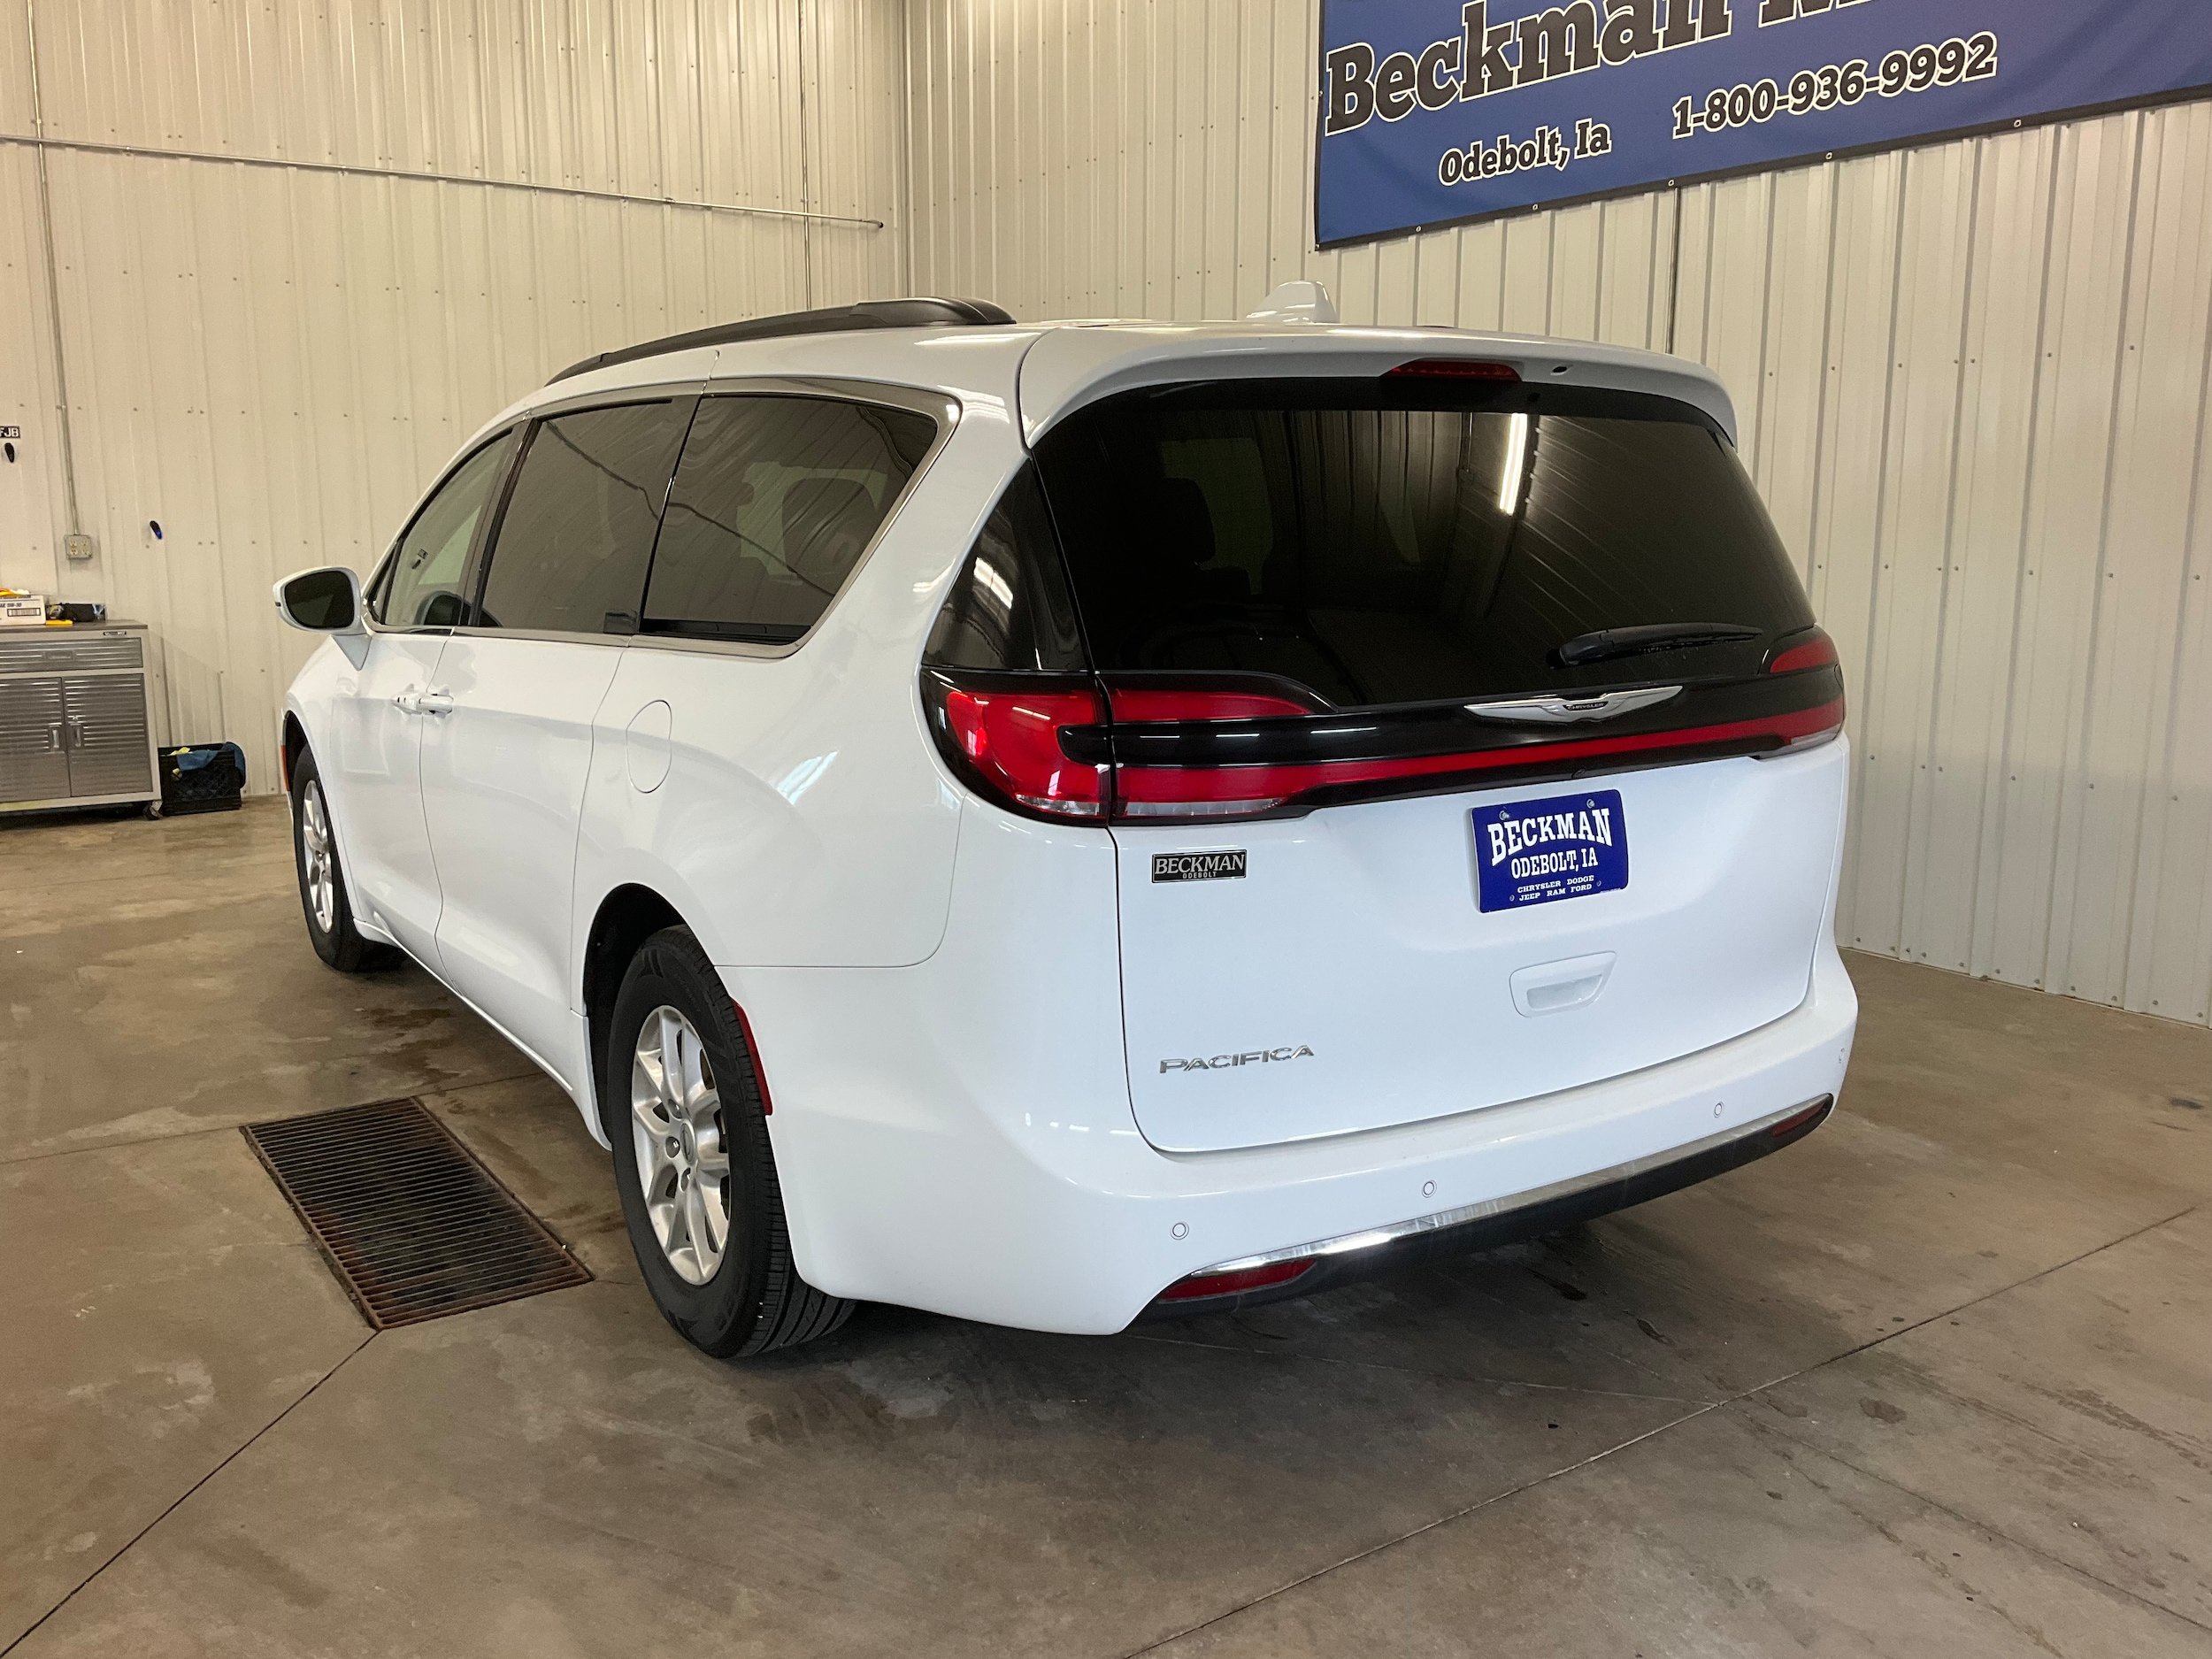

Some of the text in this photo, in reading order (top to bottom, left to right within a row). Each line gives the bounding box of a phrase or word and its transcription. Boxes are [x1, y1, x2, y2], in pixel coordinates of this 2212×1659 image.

[1325, 0, 1732, 136] Beckman
[1672, 31, 1997, 139] 1-800-936-9992
[1439, 118, 1612, 186] Odebolt, Ia
[1487, 808, 1613, 866] BECKMAN
[1155, 854, 1245, 874] BECKMAN
[1510, 847, 1599, 879] ODEBOLT, IA
[1517, 875, 1594, 894] CHRYSLER DODGE
[1519, 884, 1592, 902] JEEP RAM FORD
[1159, 1044, 1315, 1073] PACIFICA
